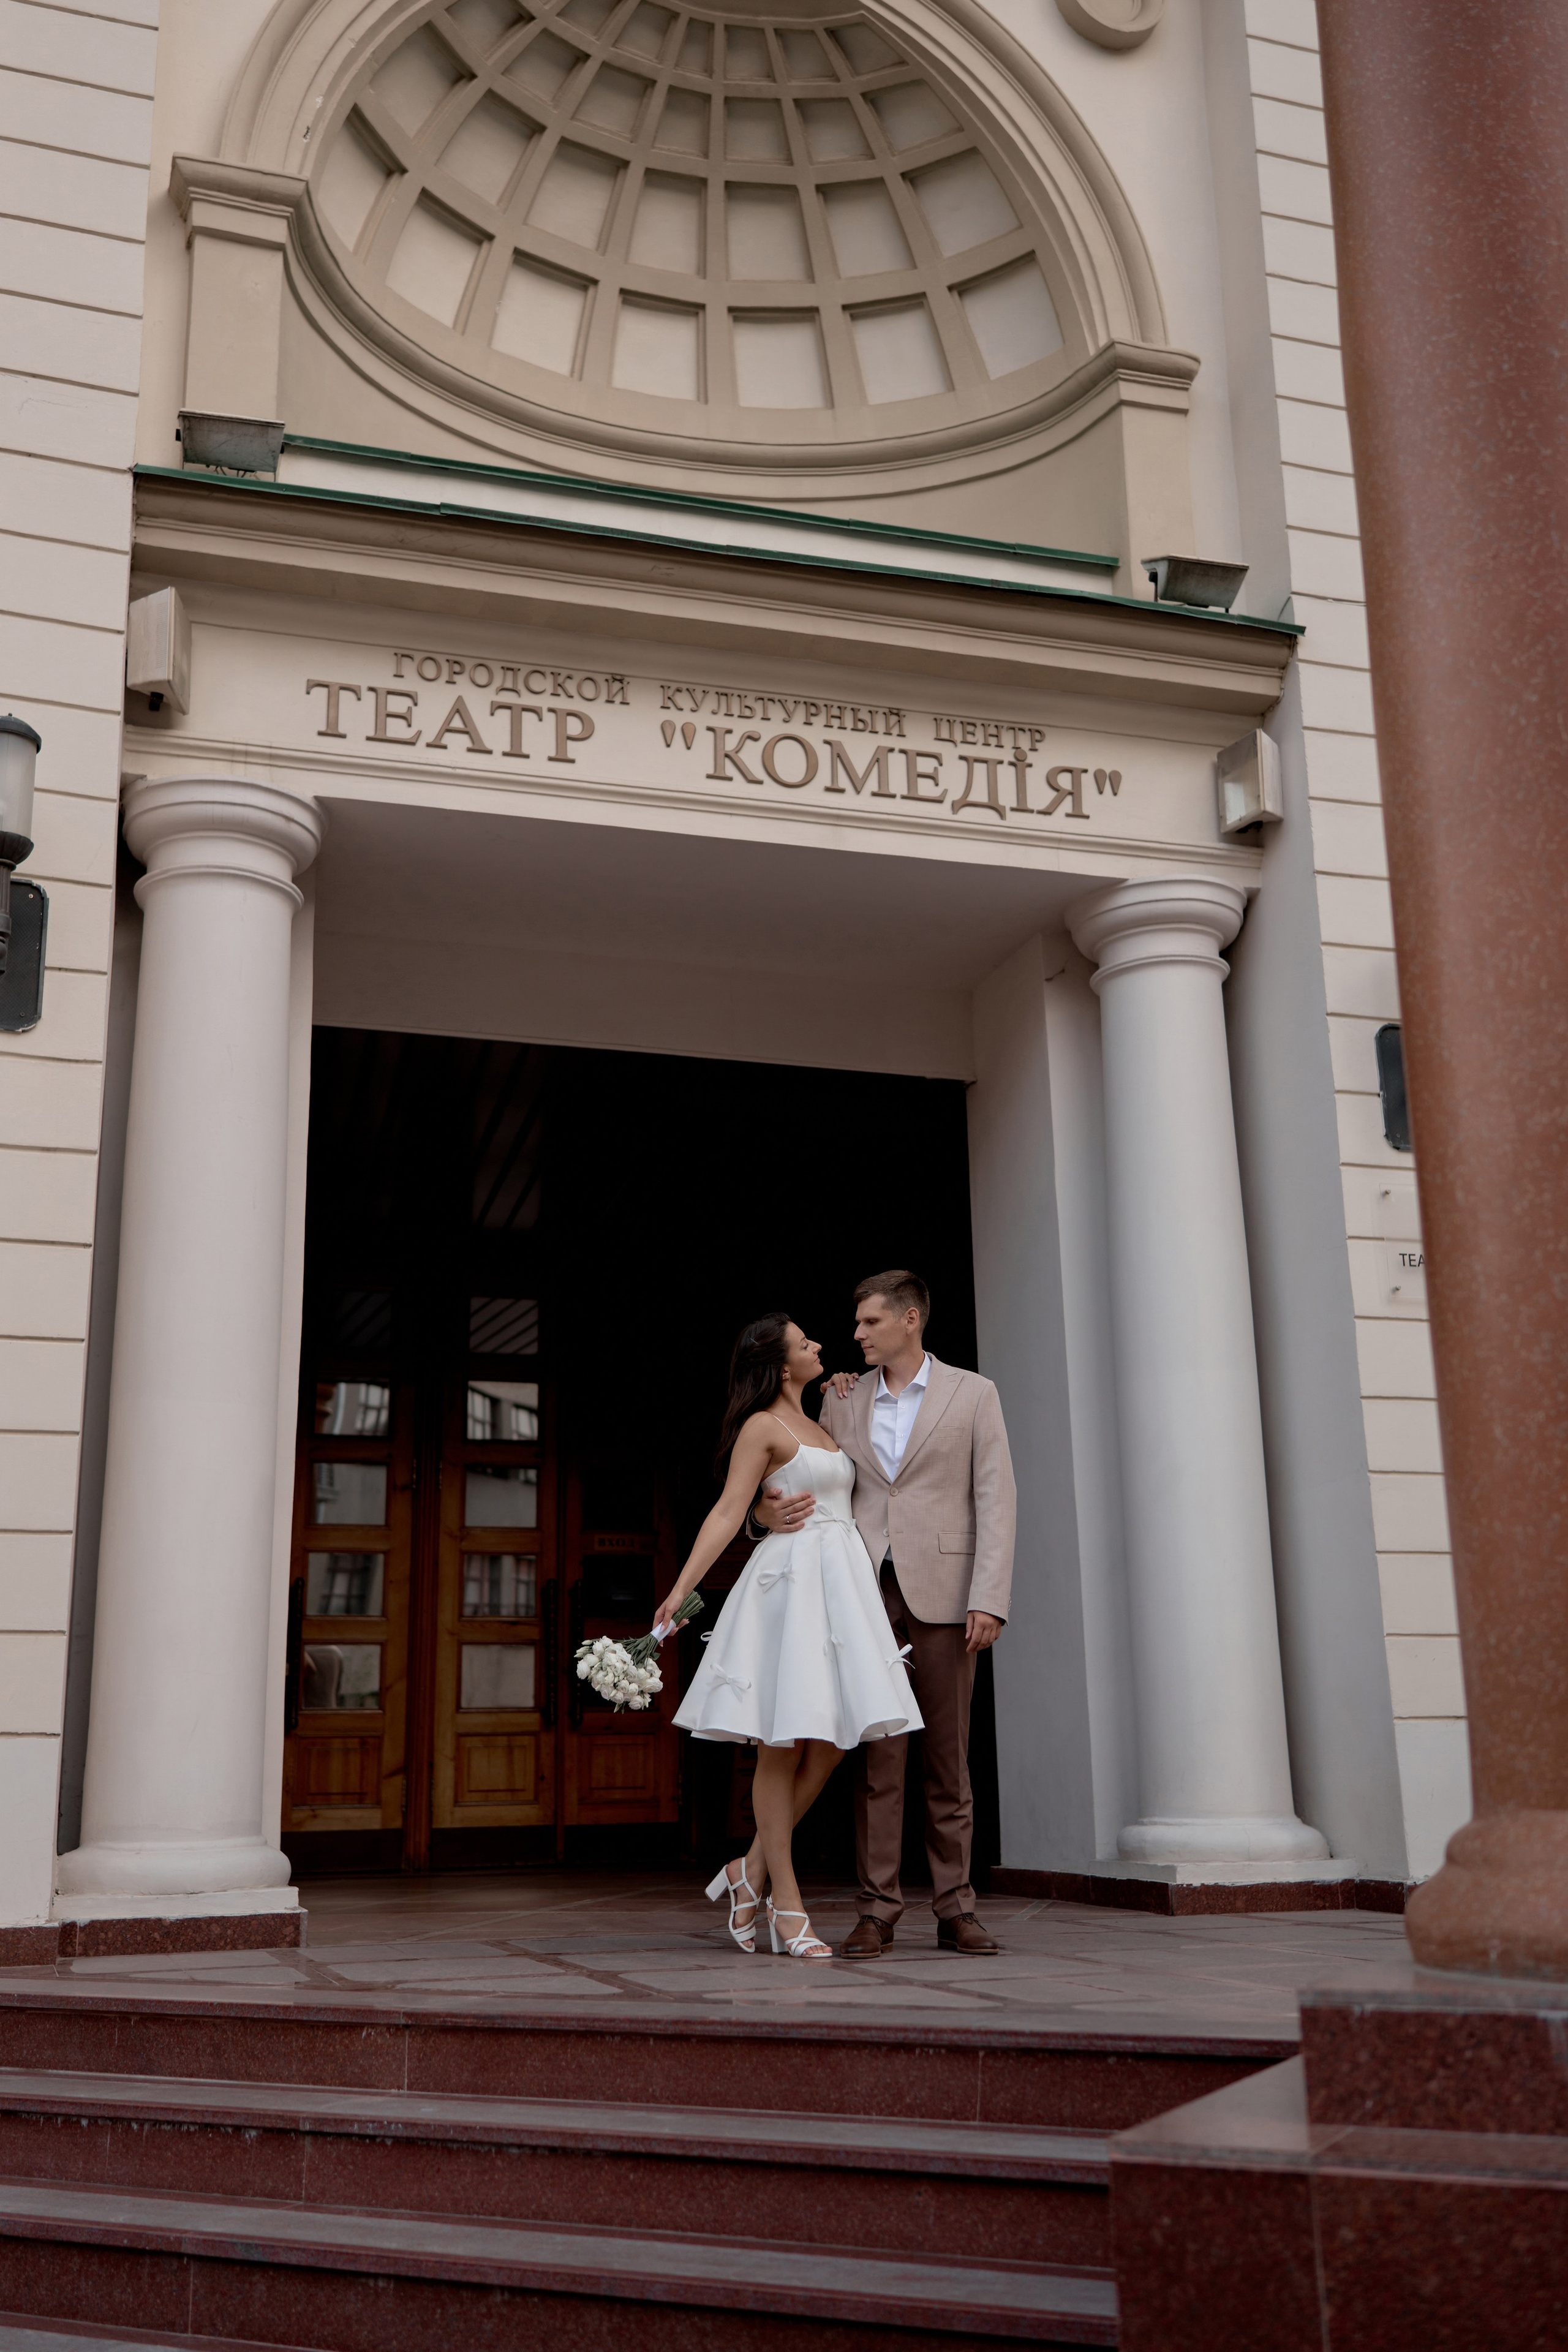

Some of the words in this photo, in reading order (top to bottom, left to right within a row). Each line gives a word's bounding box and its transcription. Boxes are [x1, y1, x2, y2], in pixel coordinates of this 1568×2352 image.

[306, 678, 595, 764] ТЕАТР
[393, 652, 630, 706] ГОРОДСКОЙ
[660, 684, 907, 737] КУЛЬТУРНЫЙ
[933, 717, 1046, 752] ЦЕНТР
[597, 1537, 635, 1548] ВХОД
